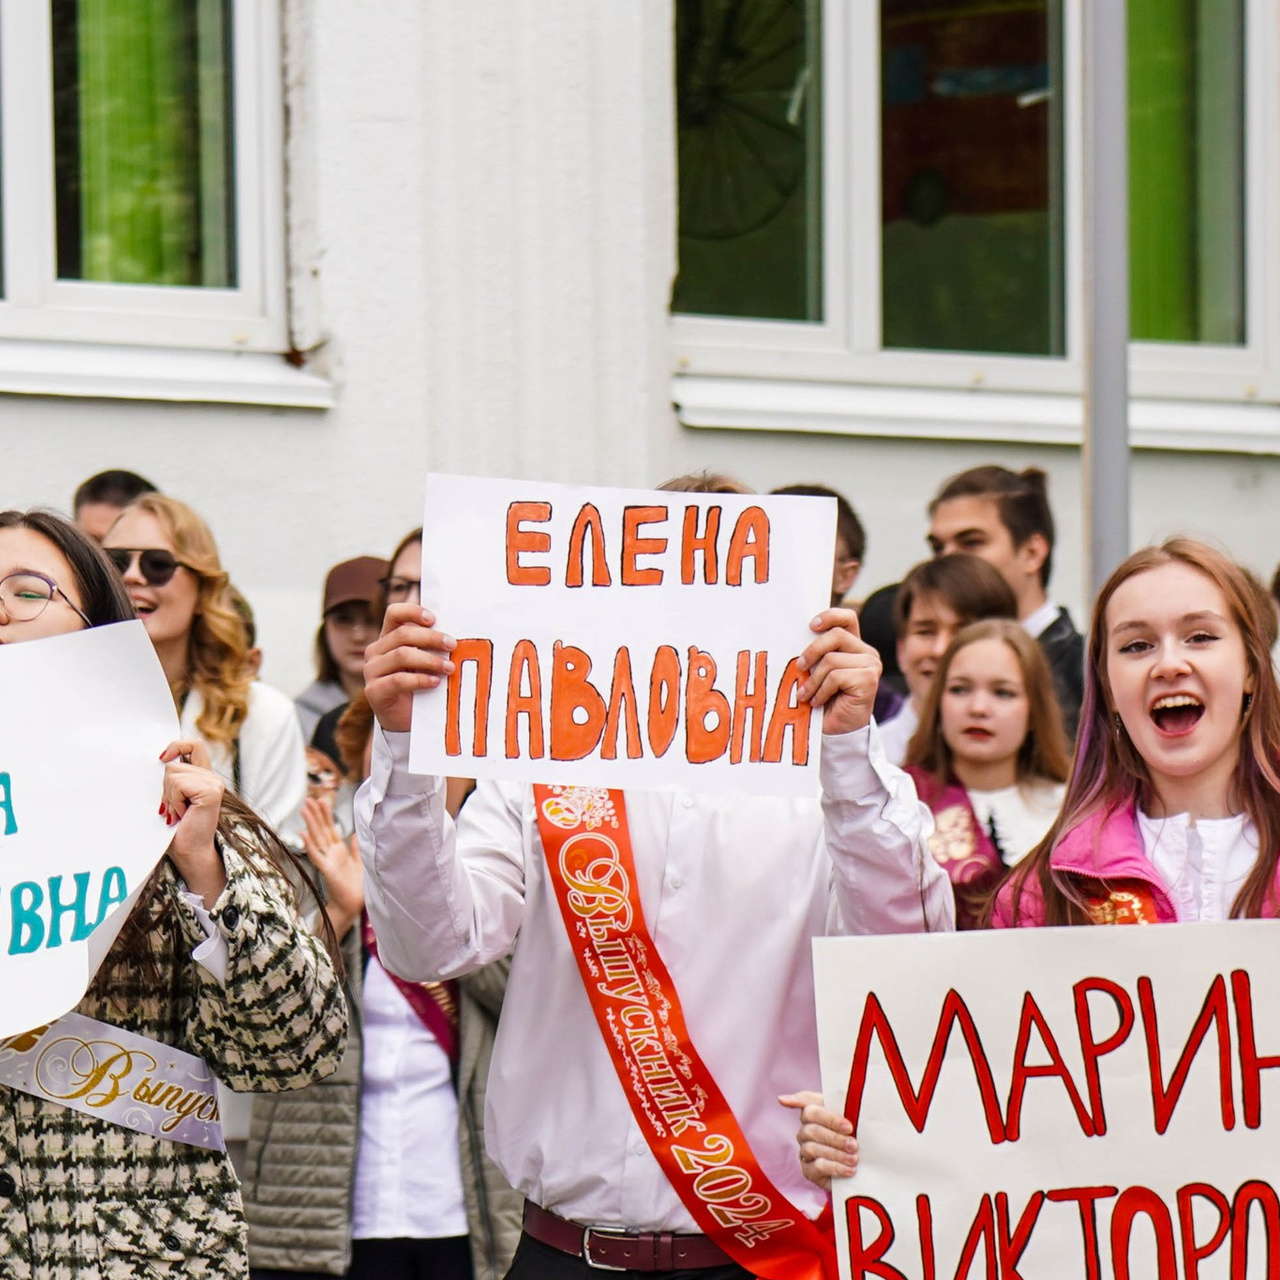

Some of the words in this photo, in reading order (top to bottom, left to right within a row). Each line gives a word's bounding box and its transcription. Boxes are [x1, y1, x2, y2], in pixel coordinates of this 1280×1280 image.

[506, 501, 770, 588] ЕЛЕНА
[445, 638, 812, 767] ПАВЛОВНА
[0, 866, 128, 955] ВНА
[35, 1037, 220, 1132] Выпус
[670, 1133, 795, 1249] 2024
